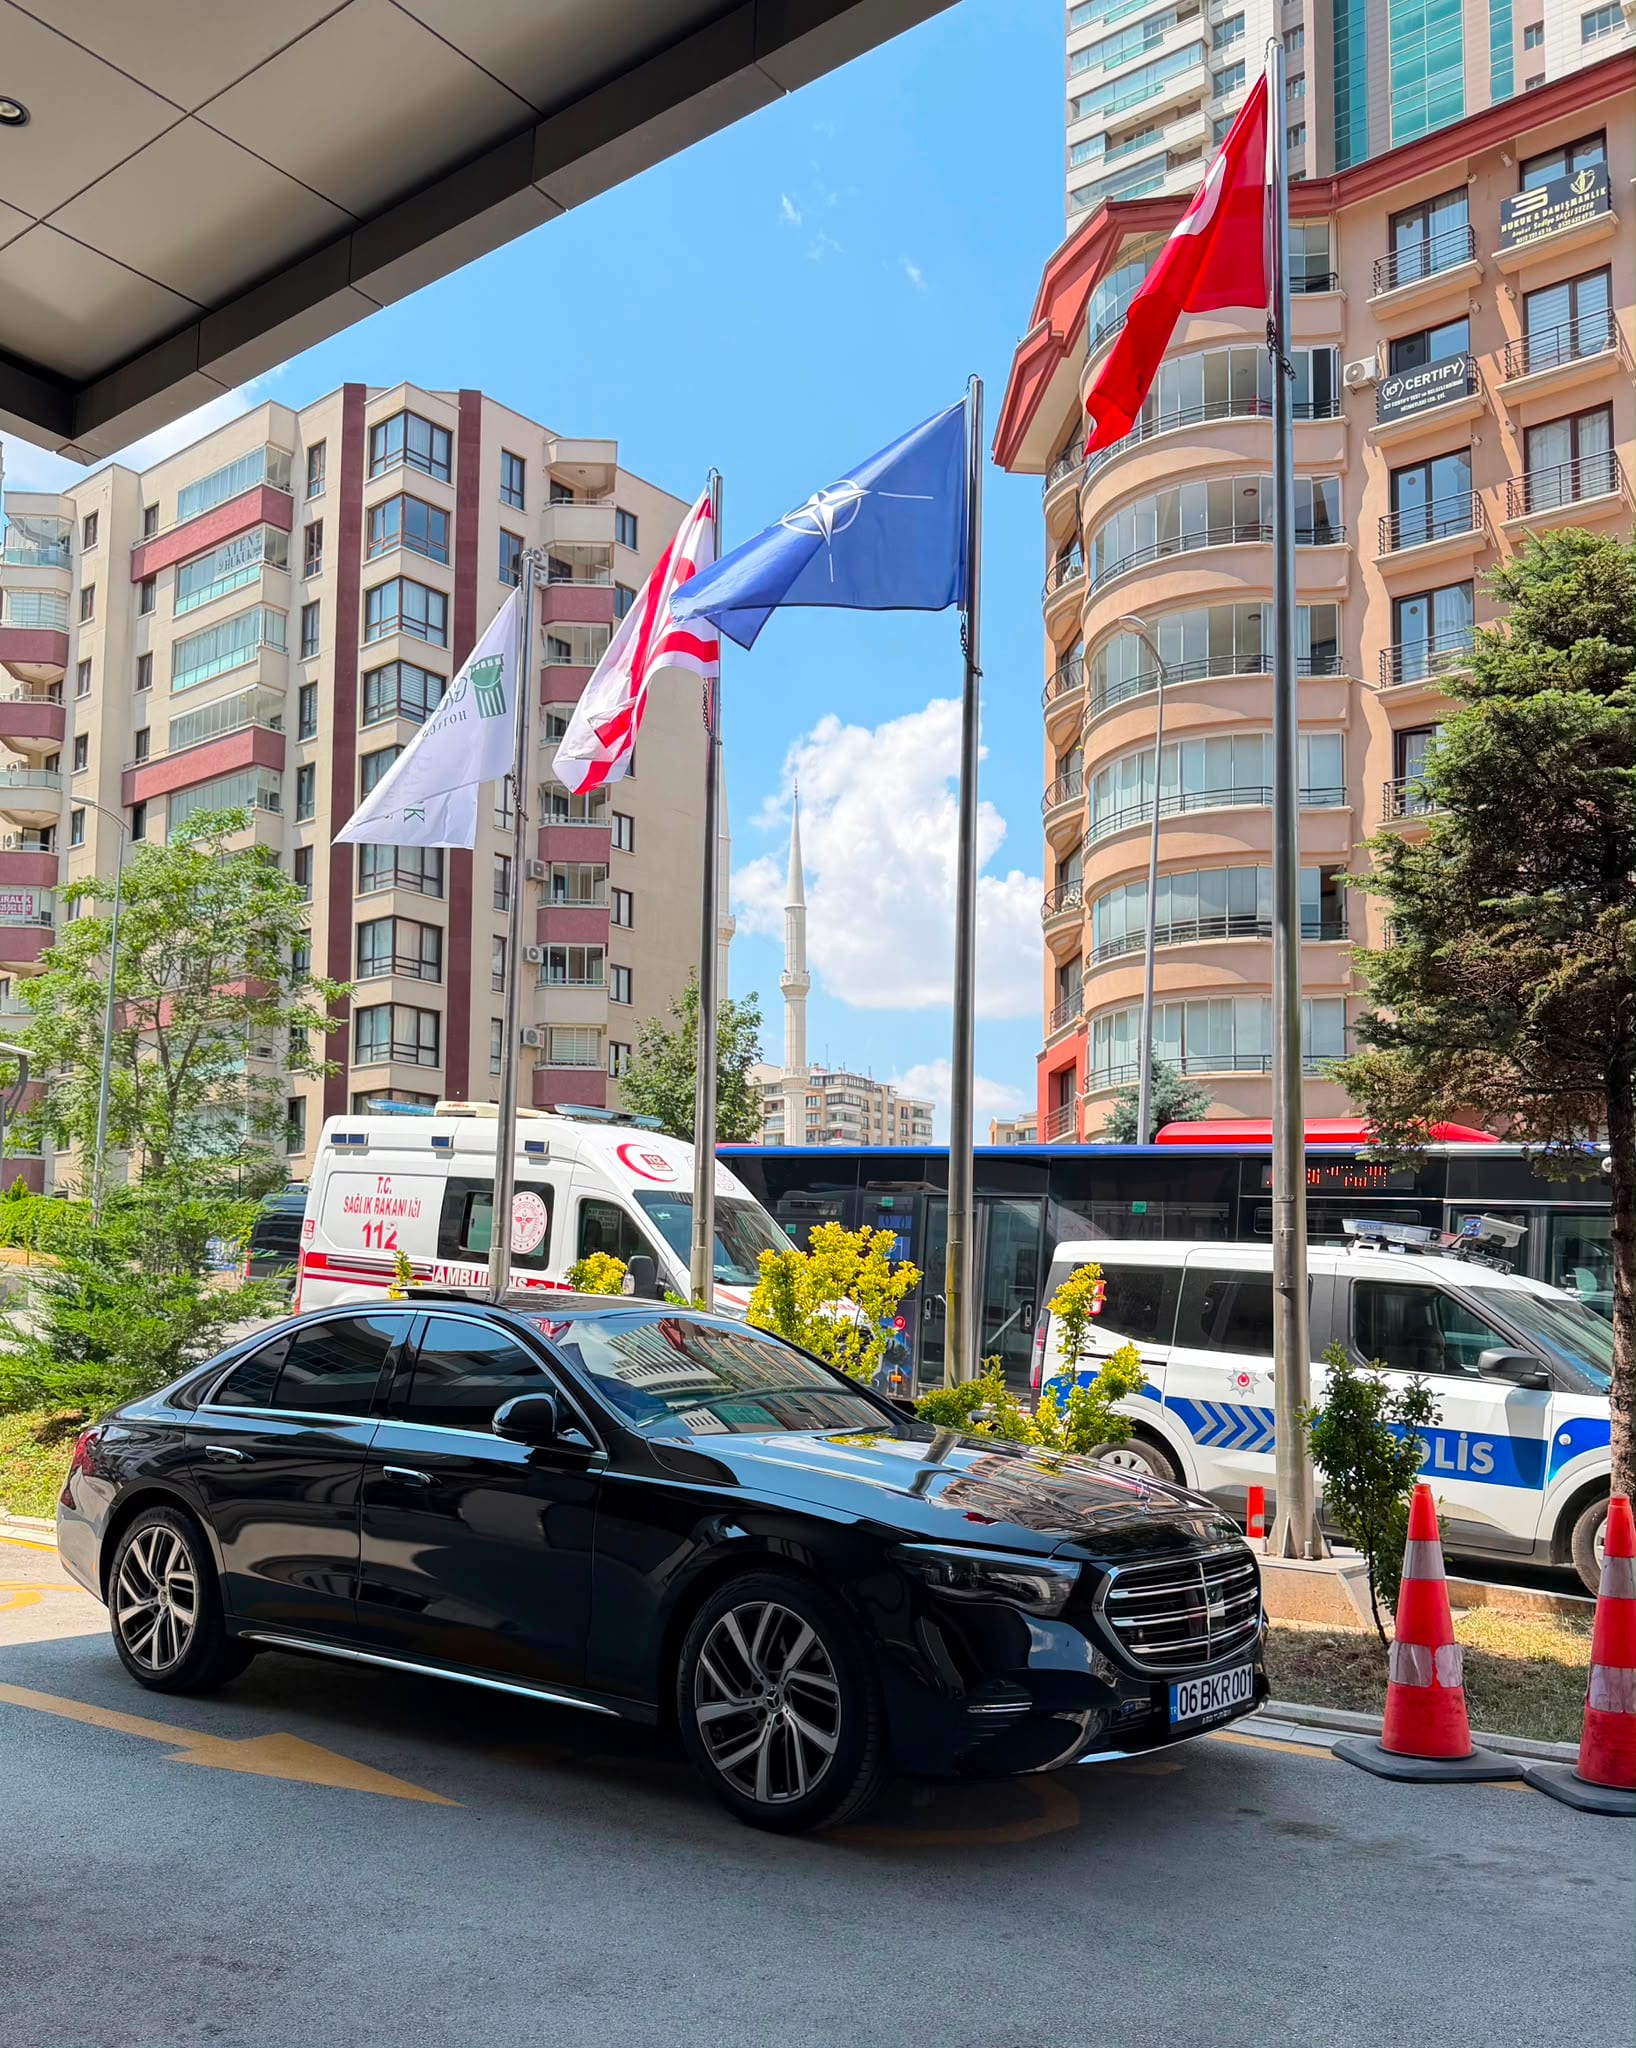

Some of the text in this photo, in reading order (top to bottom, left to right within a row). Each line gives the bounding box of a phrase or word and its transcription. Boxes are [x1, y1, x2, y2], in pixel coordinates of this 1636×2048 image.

[1501, 186, 1607, 233] HUKUK & DANIŞMANLIK
[1386, 362, 1460, 397] ICT CERTIFY
[377, 1176, 392, 1194] T.C.
[344, 1193, 421, 1218] SAĞLIK BAKANLIĞI
[362, 1220, 398, 1250] 112
[433, 1266, 528, 1289] AMBULNS
[1396, 1432, 1494, 1474] OLİS
